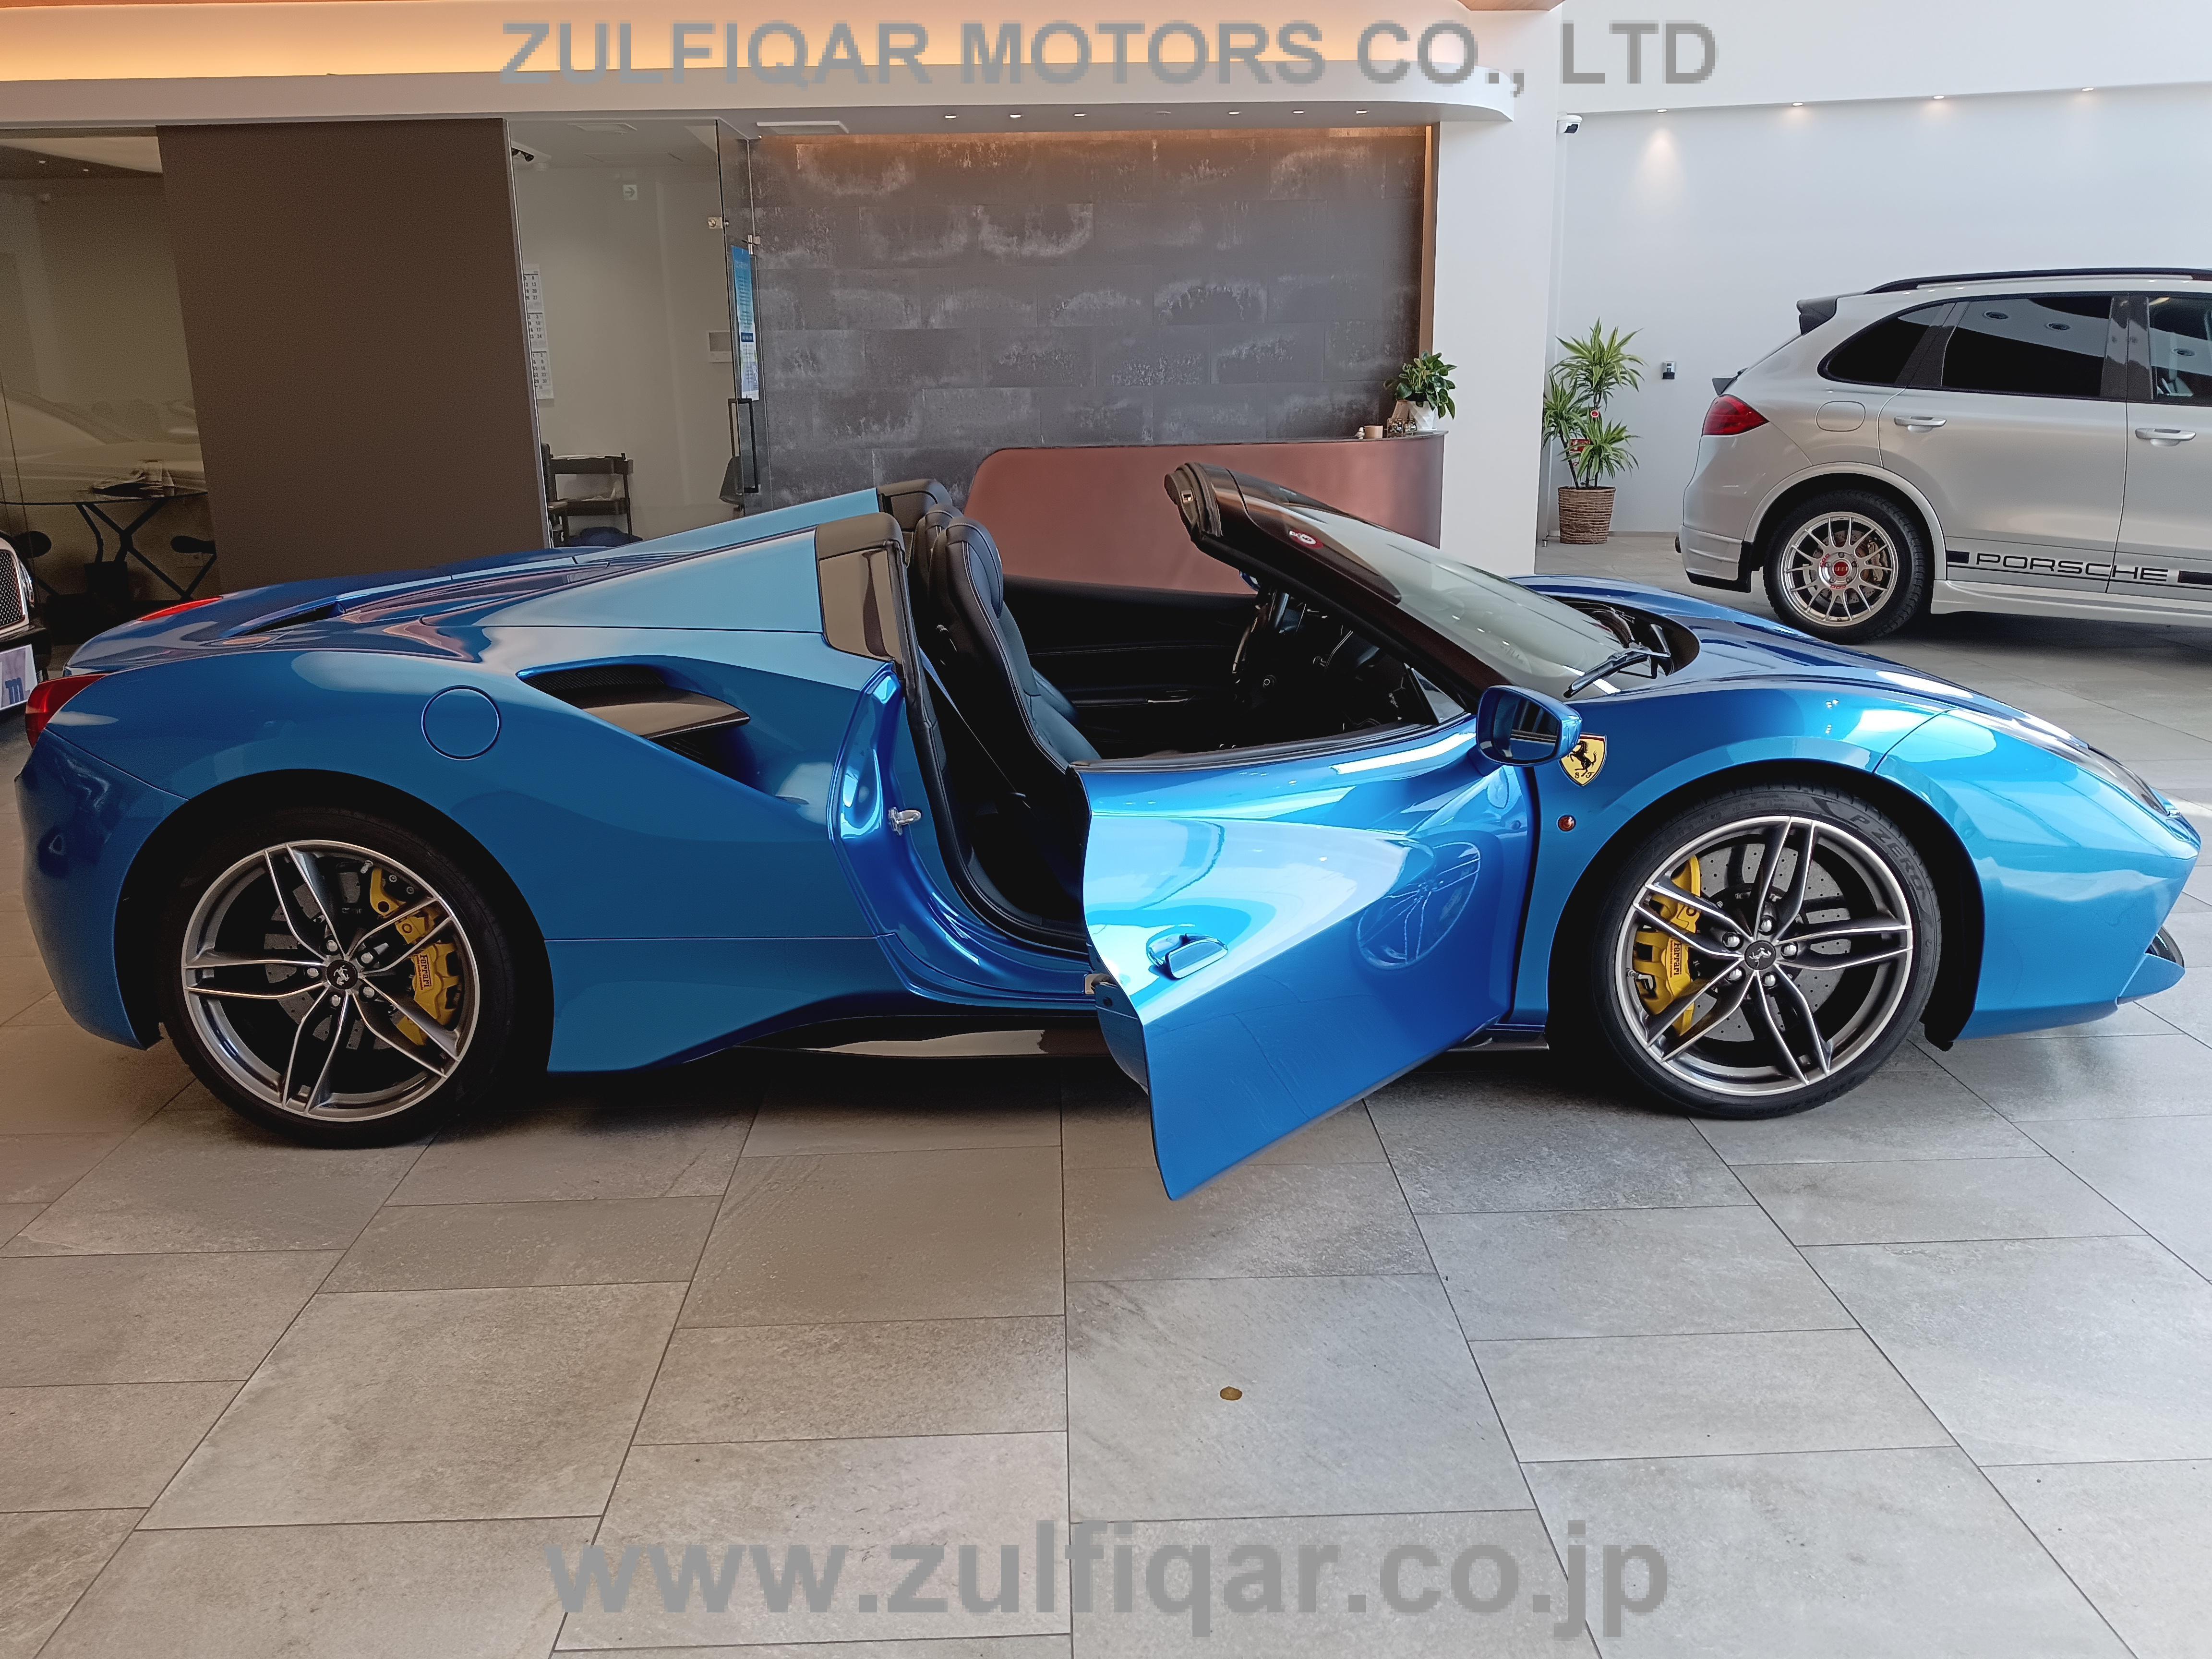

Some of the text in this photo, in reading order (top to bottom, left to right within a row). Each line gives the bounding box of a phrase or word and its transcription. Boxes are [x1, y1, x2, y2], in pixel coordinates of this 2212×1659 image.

[1976, 553, 2169, 581] PORSCHE
[1871, 828, 1925, 891] ZERO
[420, 954, 432, 987] Ferrari
